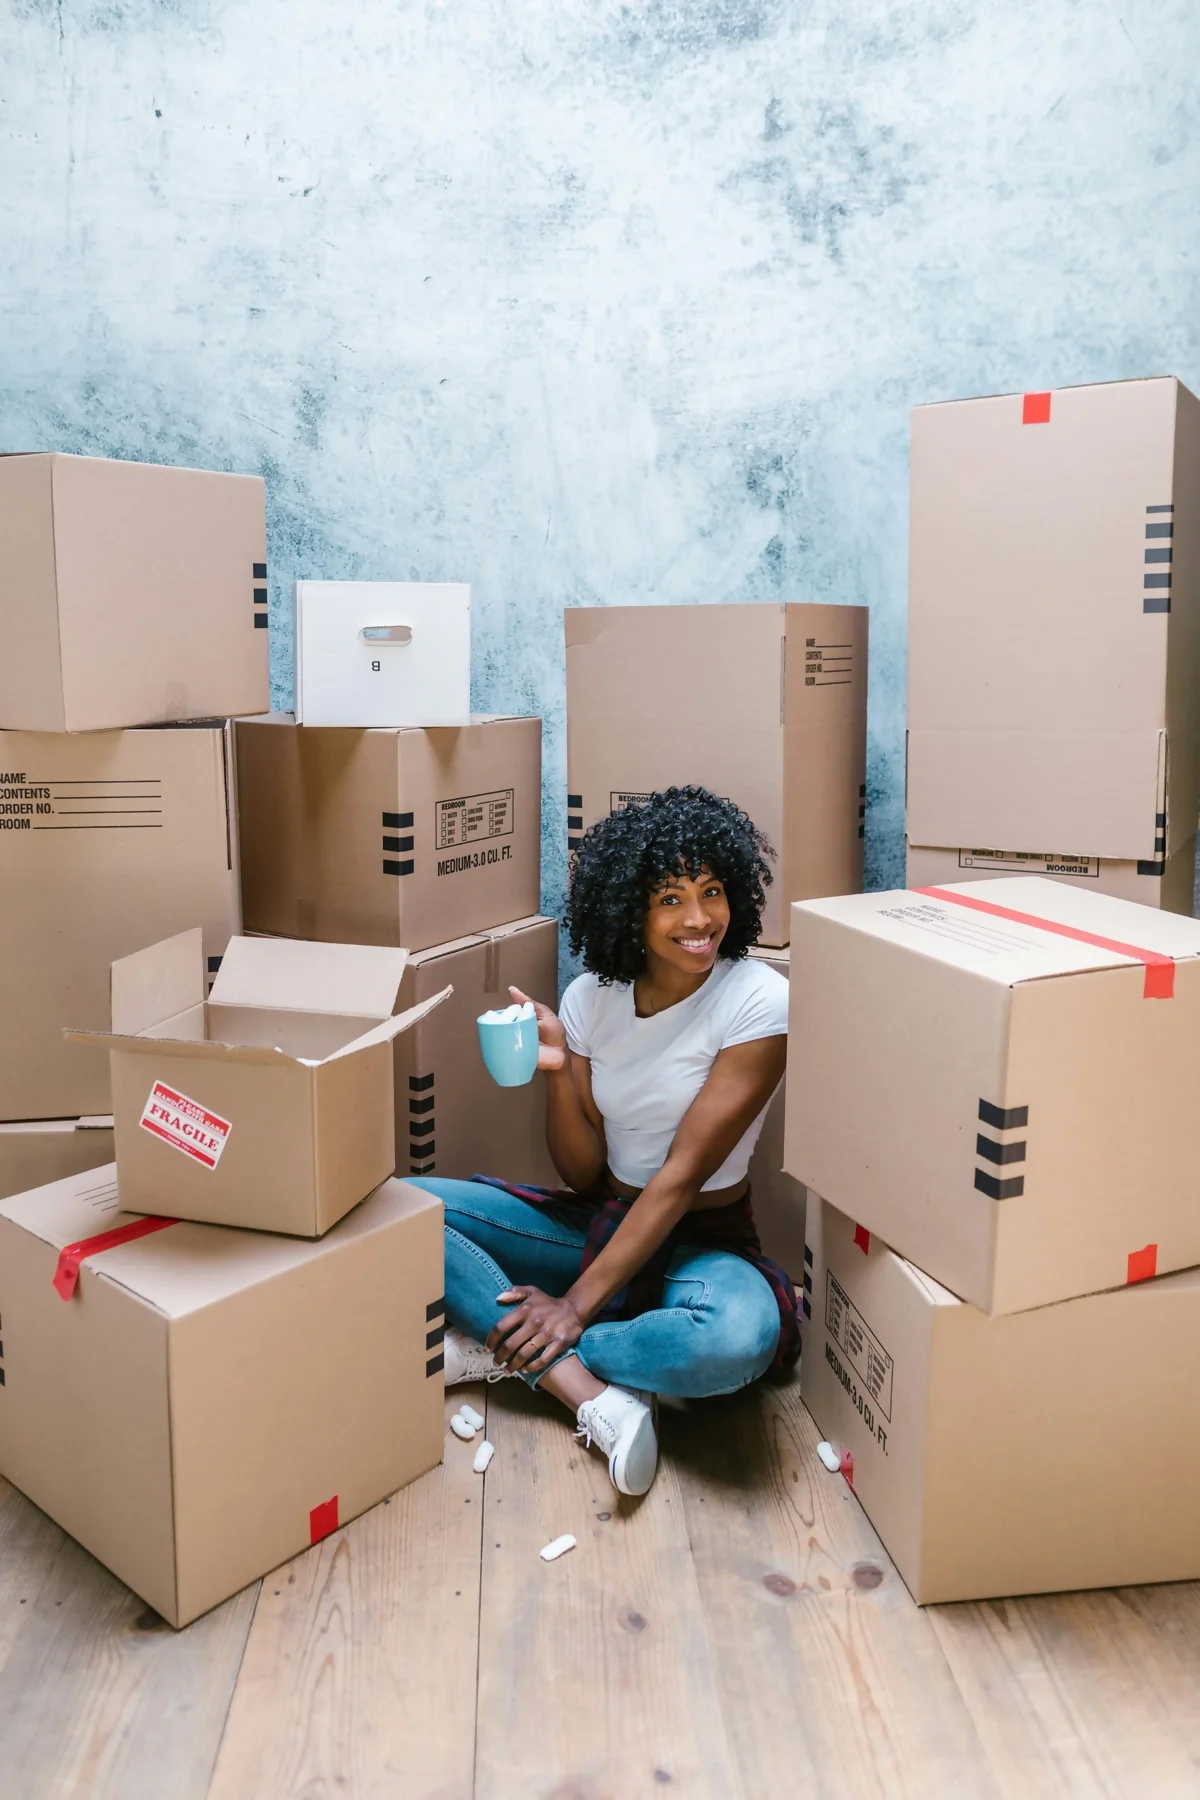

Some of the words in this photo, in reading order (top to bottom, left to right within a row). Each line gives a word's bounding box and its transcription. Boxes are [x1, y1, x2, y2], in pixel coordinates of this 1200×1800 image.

[372, 660, 380, 672] B
[36, 803, 54, 814] NO.
[442, 800, 466, 811] BEDROOM
[438, 851, 486, 876] MEDIUM-3.0
[487, 848, 500, 864] CU.
[502, 845, 512, 860] FT.
[1046, 864, 1088, 874] BEDROOM
[156, 1091, 184, 1111] HANDLE
[186, 1109, 204, 1123] WITH
[205, 1120, 225, 1134] CARE
[179, 1099, 206, 1116] PLEASE
[150, 1103, 219, 1152] FRAGILE
[825, 1342, 863, 1415] MEDIUM-3.0
[864, 1404, 876, 1437] CU.
[877, 1425, 888, 1456] FT.
